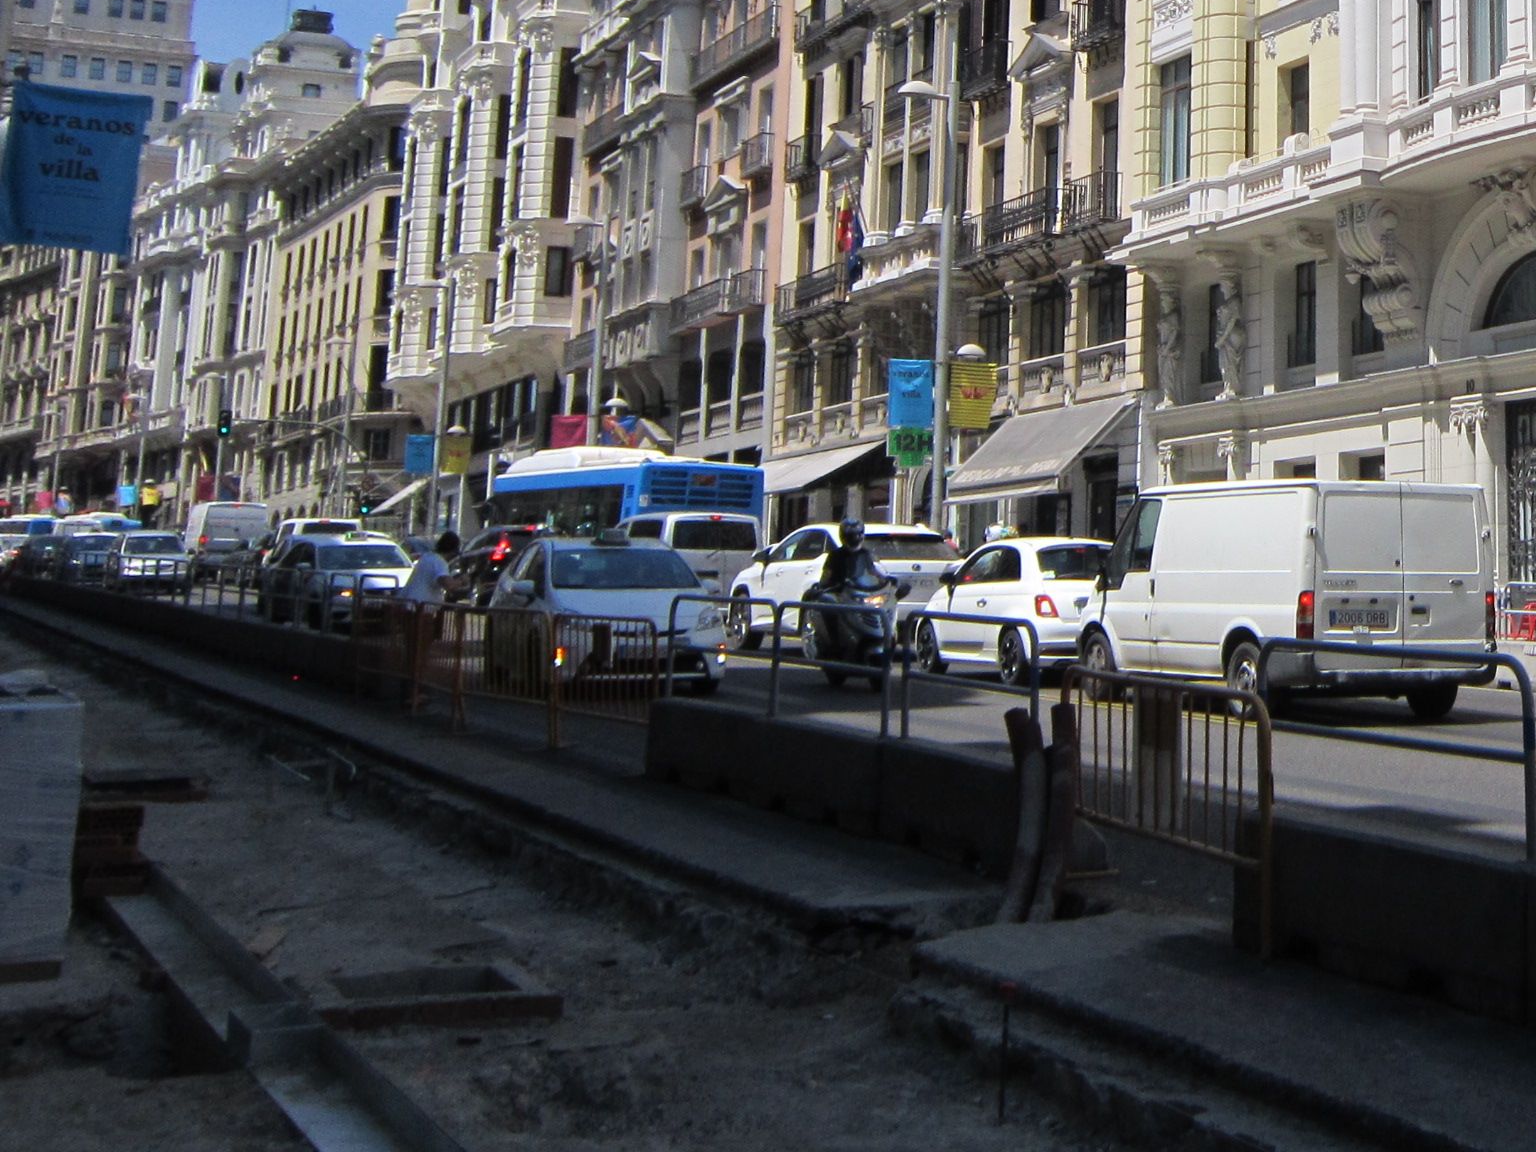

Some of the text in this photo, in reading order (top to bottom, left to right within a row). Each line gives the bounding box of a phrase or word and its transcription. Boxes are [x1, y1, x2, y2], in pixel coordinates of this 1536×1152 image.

[18, 109, 136, 137] veranos
[54, 133, 93, 157] de la
[40, 159, 100, 183] villa
